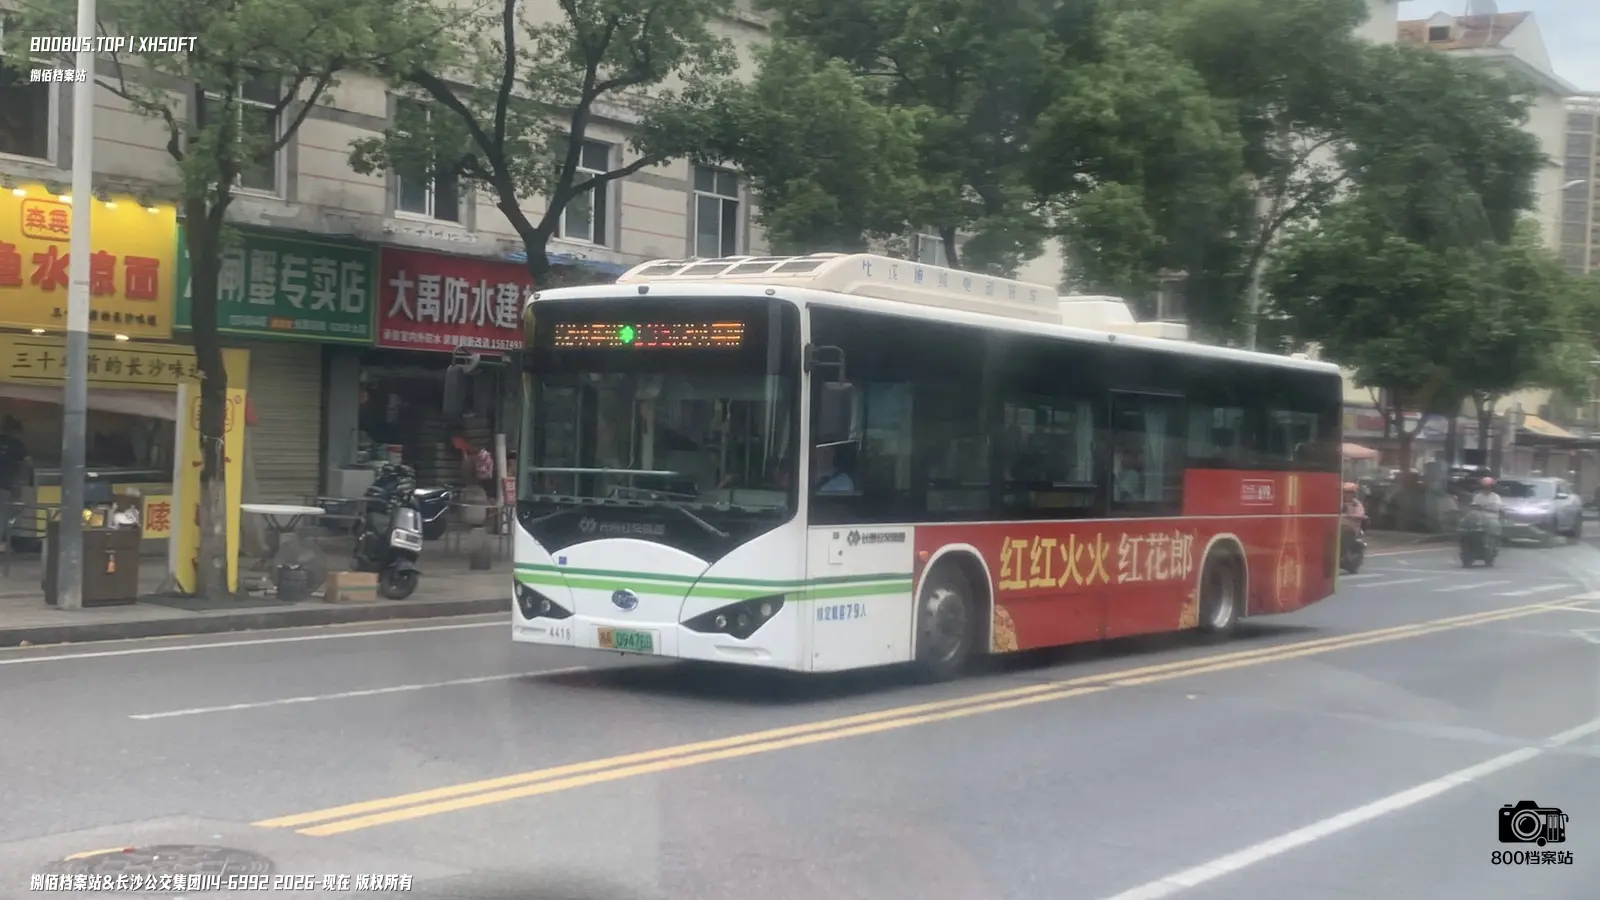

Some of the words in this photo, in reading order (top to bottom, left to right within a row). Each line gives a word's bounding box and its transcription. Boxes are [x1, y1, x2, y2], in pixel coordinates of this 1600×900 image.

[184, 248, 366, 313] 闸蟹专卖店
[12, 351, 202, 379] 三十前的长沙味
[999, 533, 1111, 590] 红红火火
[1117, 530, 1195, 585] 红花郎
